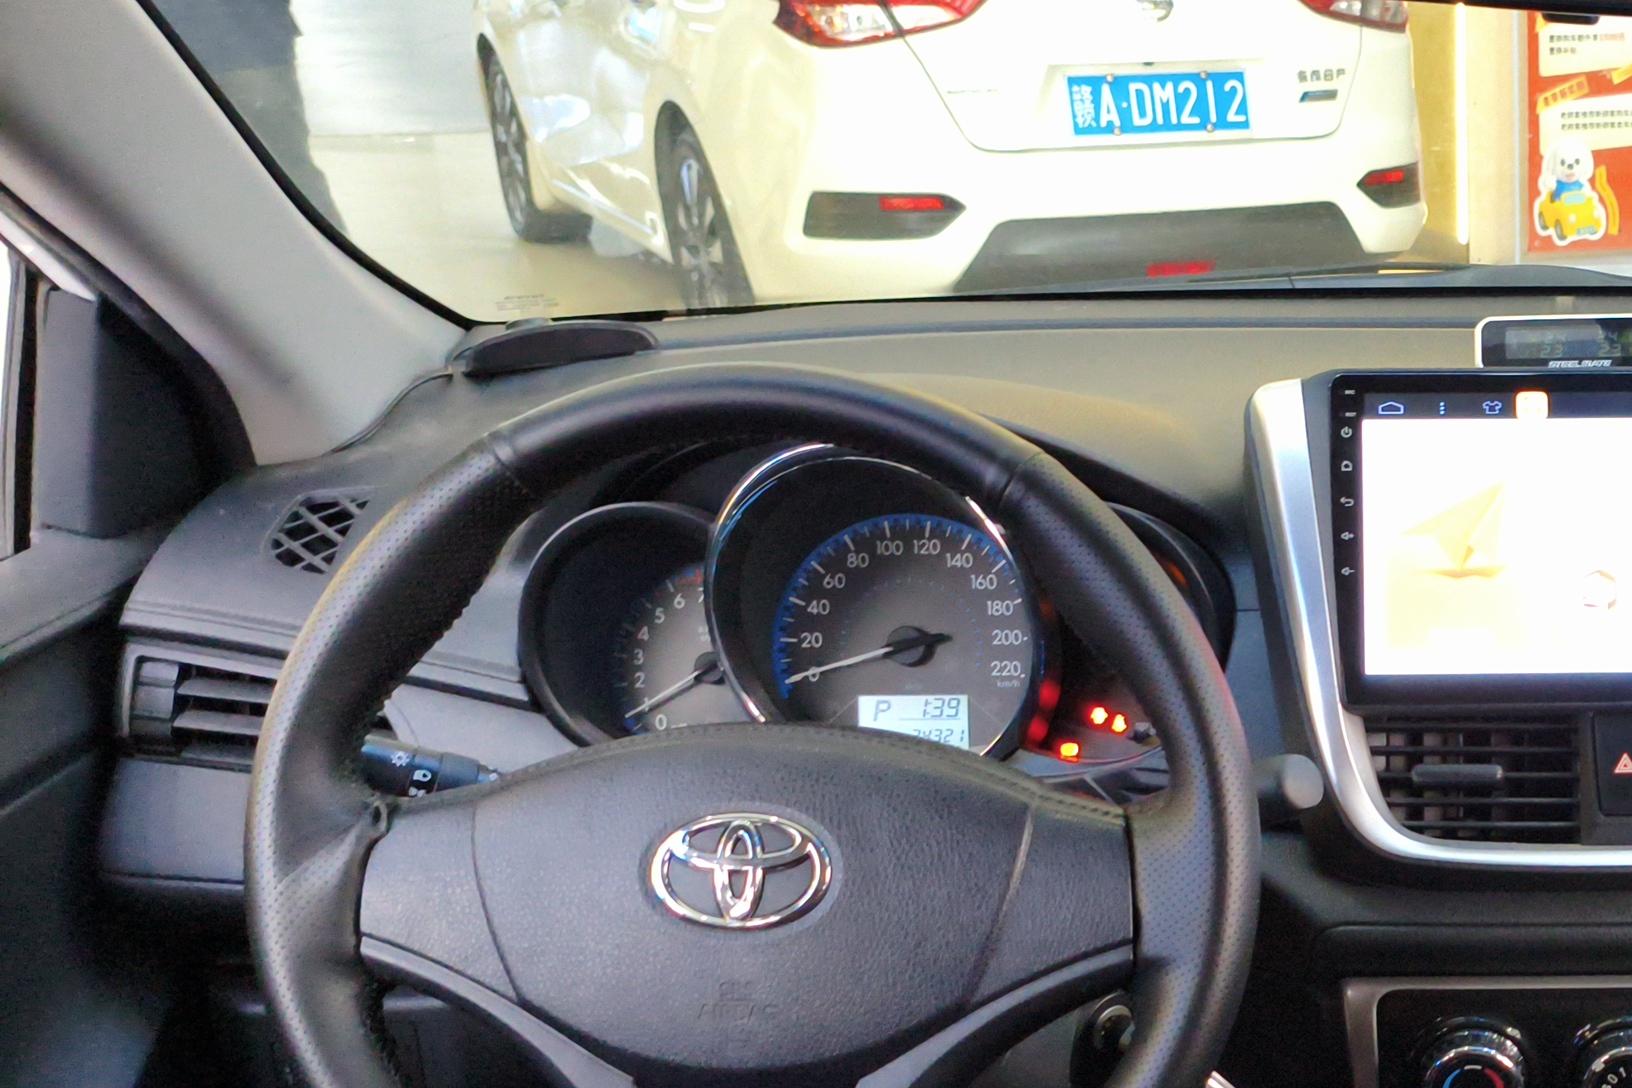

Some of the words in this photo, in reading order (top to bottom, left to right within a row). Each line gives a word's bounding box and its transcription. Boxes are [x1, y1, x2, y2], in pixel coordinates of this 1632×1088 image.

[876, 540, 904, 556] 100
[913, 539, 941, 555] 120
[847, 552, 869, 568] 80
[946, 552, 973, 569] 140
[823, 573, 846, 589] 60
[971, 574, 998, 590] 160
[673, 593, 686, 609] 6
[807, 599, 830, 615] 40
[987, 600, 1014, 616] 180
[655, 608, 665, 624] 5
[637, 626, 650, 641] 4
[801, 632, 823, 648] 20
[992, 629, 1022, 645] 200
[633, 650, 644, 665] 3
[990, 661, 1021, 677] 220
[634, 672, 645, 688] 2
[873, 699, 891, 722] P
[655, 714, 668, 730] 0
[1607, 1073, 1618, 1084] 0
[1619, 1066, 1626, 1078] 1
